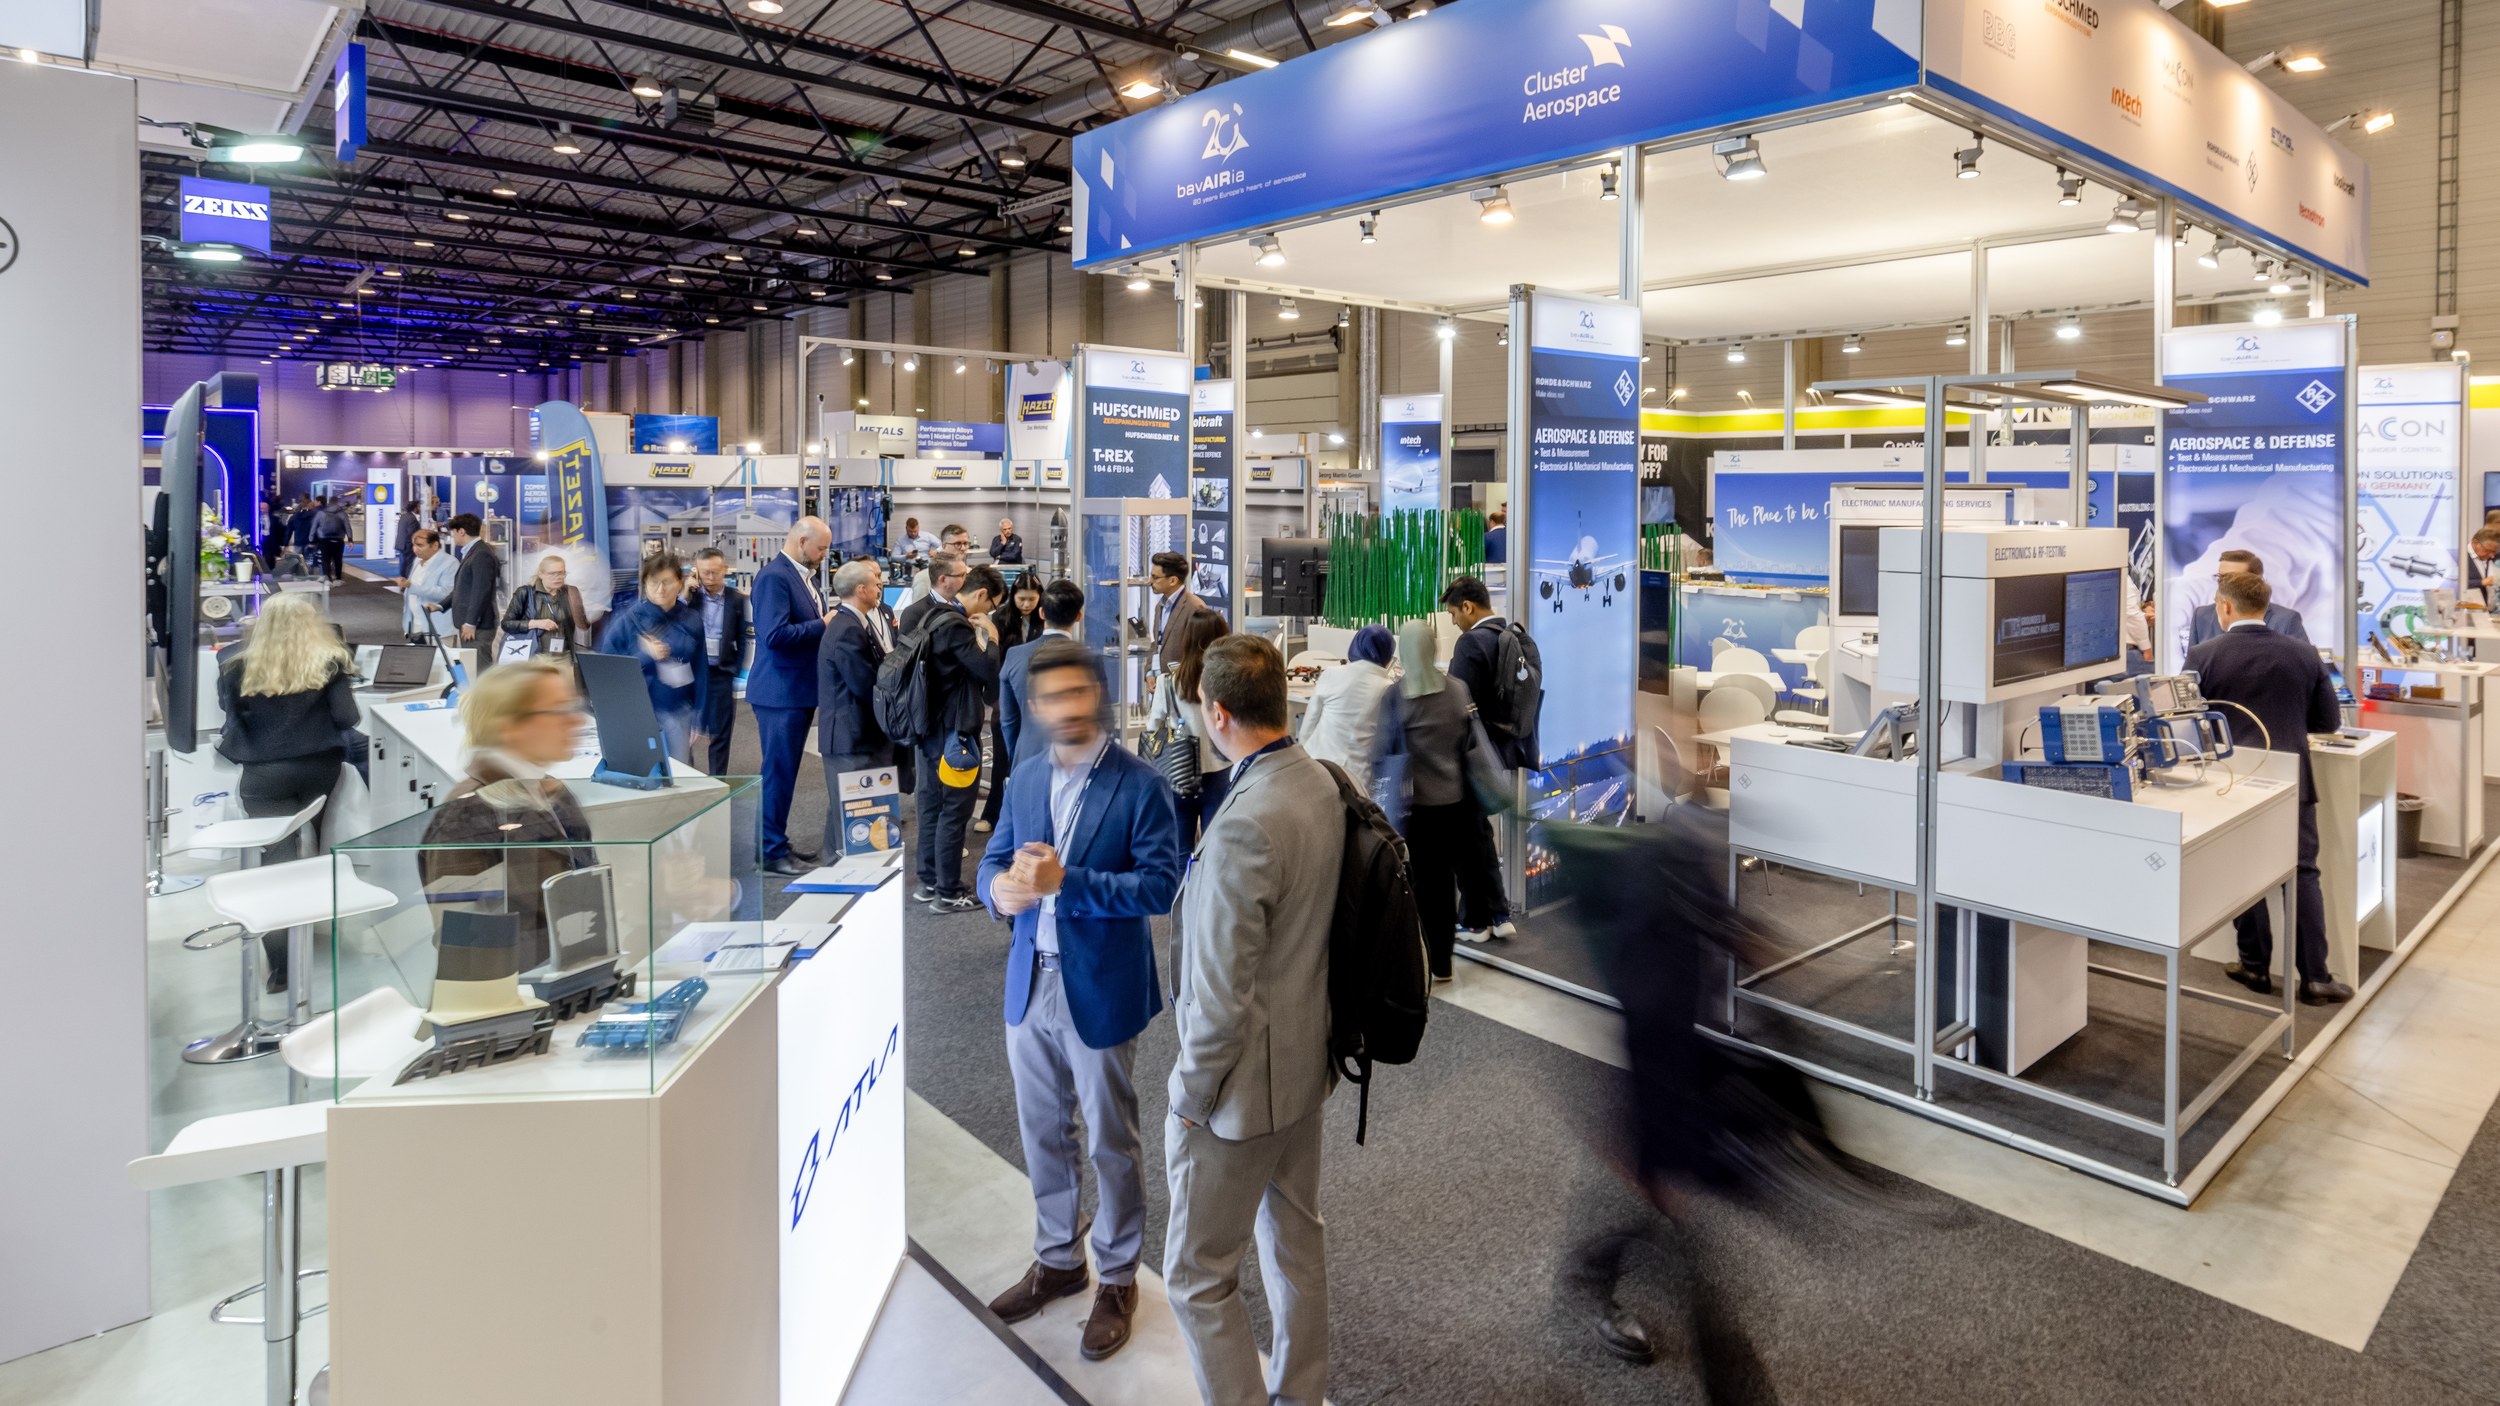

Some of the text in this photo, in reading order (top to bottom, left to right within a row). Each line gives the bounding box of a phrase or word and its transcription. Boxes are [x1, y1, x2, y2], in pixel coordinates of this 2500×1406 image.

[1983, 9, 2016, 53] BBG
[1524, 65, 1588, 96] Cluster
[1523, 85, 1621, 124] Aerospace
[1177, 170, 1245, 198] bavAIRia
[1203, 194, 1218, 205] years
[1219, 187, 1244, 199] Europe's
[1246, 183, 1263, 192] heart
[1264, 180, 1272, 188] of
[1273, 172, 1307, 186] aerospace
[184, 195, 268, 221] ZEISS
[1535, 377, 1591, 389] ROHDE&SCHWARZ
[1022, 399, 1055, 416] HAZET
[1193, 416, 1224, 428] olcraft
[1535, 427, 1635, 445] AEROSPACE & DEFENSE
[2169, 436, 2250, 451] AEROSPACE
[2253, 436, 2266, 449] &
[2269, 434, 2336, 449] DEFENSE
[301, 456, 328, 464] LANG
[1093, 448, 1134, 463] T-REX
[1540, 447, 1589, 458] Test & Measurement
[1648, 444, 1668, 461] FOR
[2177, 453, 2254, 461] Test & Measurement
[1094, 464, 1134, 473] 194 & FB194
[1540, 461, 1568, 471] Electronical
[1574, 461, 1601, 471] Mechanical
[1601, 462, 1634, 472] Manufacturing
[2177, 463, 2335, 473] Electronical & Mechanical Manufacturing
[1841, 499, 1886, 507] ELECTRONIC
[1956, 500, 1992, 508] SERVICES
[1727, 507, 1749, 529] The
[1752, 505, 1783, 526] Place
[1784, 504, 1798, 523] to
[1801, 502, 1819, 520] be
[1995, 545, 2066, 561] ELECTRONICS & RF-TESTING
